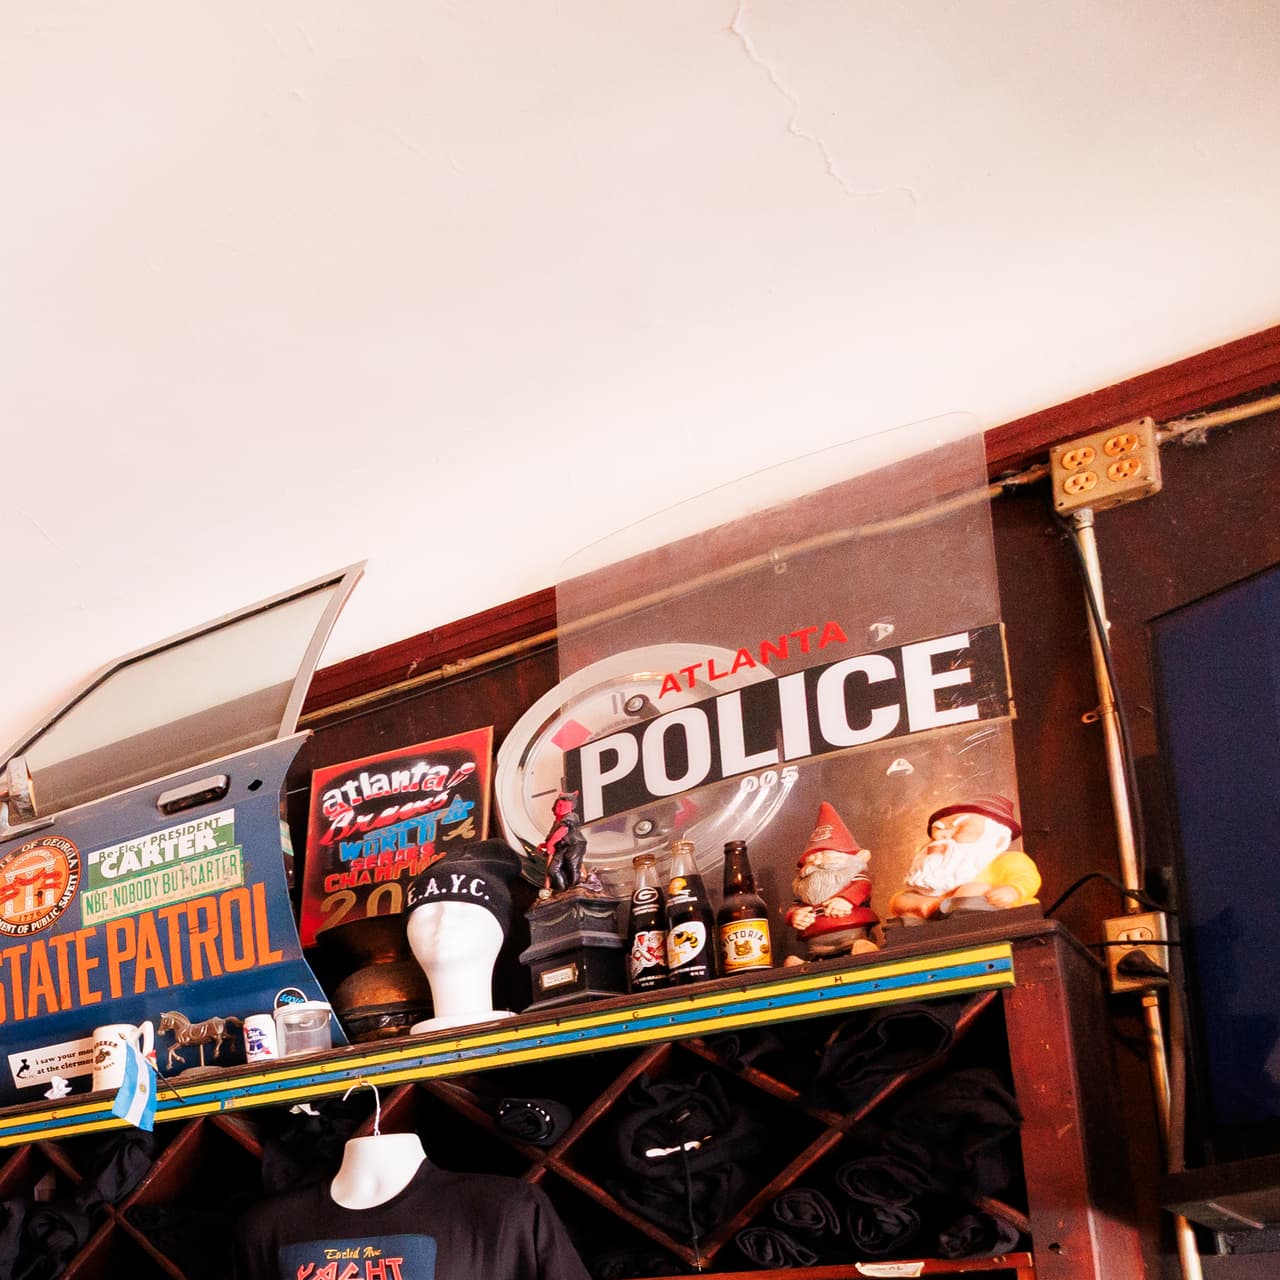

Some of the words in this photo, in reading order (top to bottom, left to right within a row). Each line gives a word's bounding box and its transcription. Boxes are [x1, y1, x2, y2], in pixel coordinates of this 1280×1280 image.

[658, 622, 849, 698] ATLANTA
[580, 632, 980, 823] POLICE
[322, 762, 449, 819] atlanta
[740, 766, 799, 793] 005
[151, 817, 220, 846] PRESIDENT
[340, 822, 437, 861] WORLD
[21, 841, 38, 852] OF
[42, 838, 79, 869] GEORGIA
[100, 829, 217, 879] CARTER
[351, 843, 435, 871] SERIES
[17, 925, 30, 934] OF
[31, 907, 61, 932] PUBLIC
[58, 874, 78, 909] SAFETY
[407, 874, 490, 907] E.A.Y.C.
[105, 883, 284, 998] PATROL
[47, 1065, 60, 1073] the
[57, 1052, 76, 1062] your
[324, 1247, 359, 1260] Euclid
